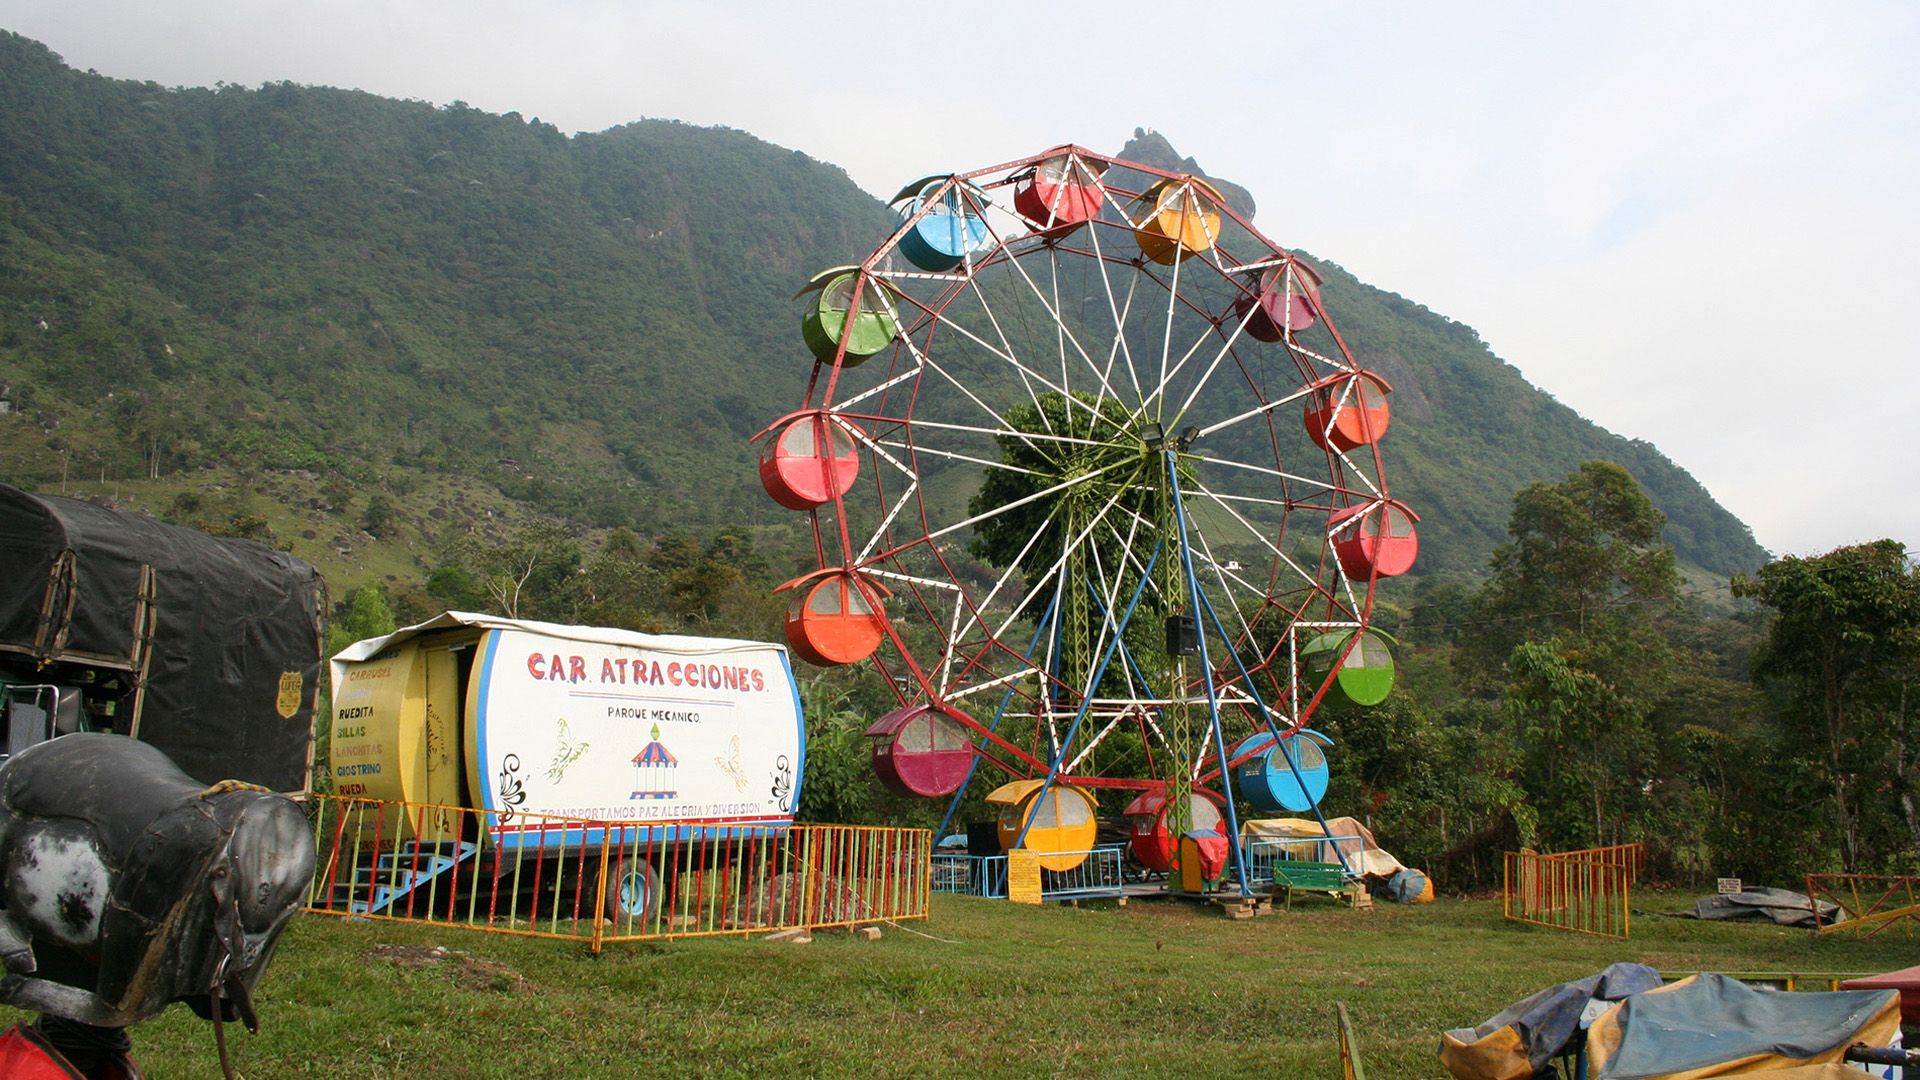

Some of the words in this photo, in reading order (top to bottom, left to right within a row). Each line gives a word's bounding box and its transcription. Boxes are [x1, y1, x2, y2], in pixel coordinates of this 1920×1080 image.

[349, 667, 392, 681] CARRUSEL
[339, 706, 374, 719] RUEDITA
[337, 726, 366, 738] SILLAS
[336, 744, 383, 757] LANCHITAS
[337, 763, 381, 776] GIOSTRINO
[339, 783, 367, 795] RUEDA
[639, 806, 659, 818] PAZ
[704, 804, 712, 815] Y
[713, 802, 761, 815] DIVERSION
